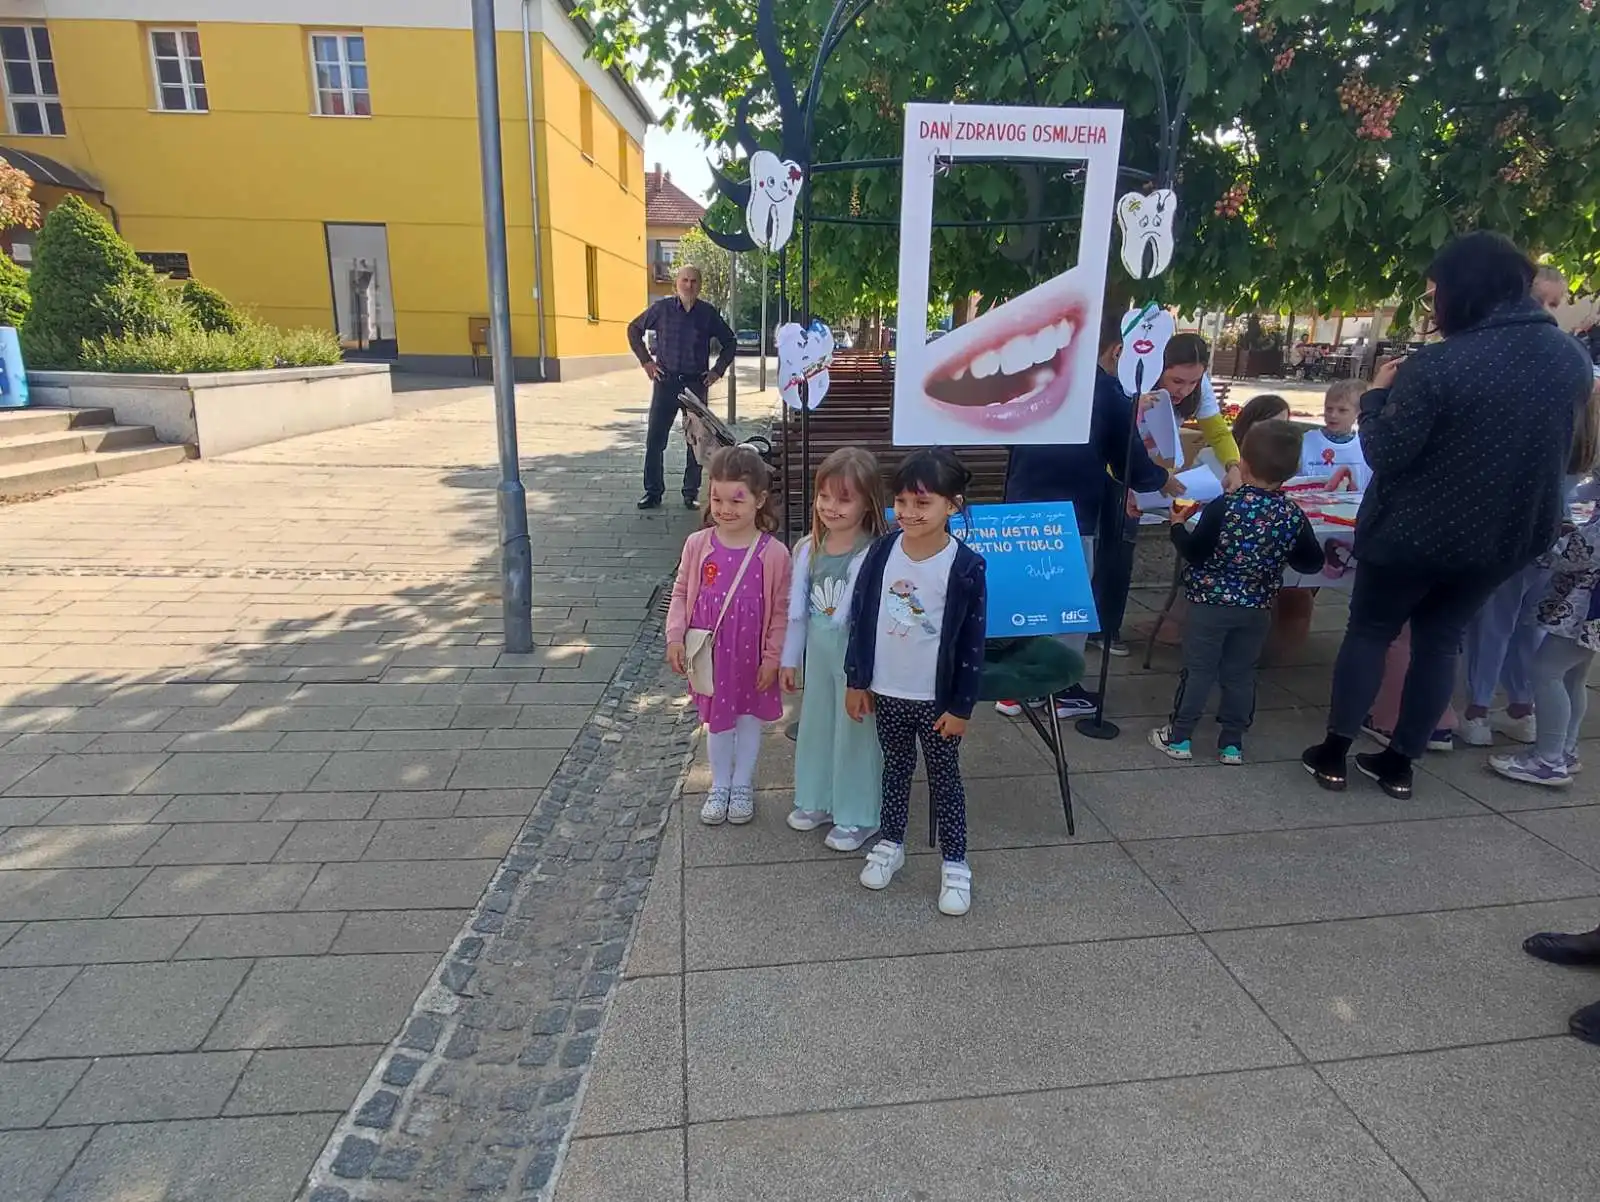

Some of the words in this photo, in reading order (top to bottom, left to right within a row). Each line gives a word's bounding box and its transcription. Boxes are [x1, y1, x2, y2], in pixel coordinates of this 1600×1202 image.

[920, 121, 950, 139] DAN
[955, 122, 1027, 142] ZDRAVOG
[1032, 124, 1107, 144] OSMIJEHA
[1002, 525, 1040, 538] USTA
[1043, 524, 1063, 536] SU
